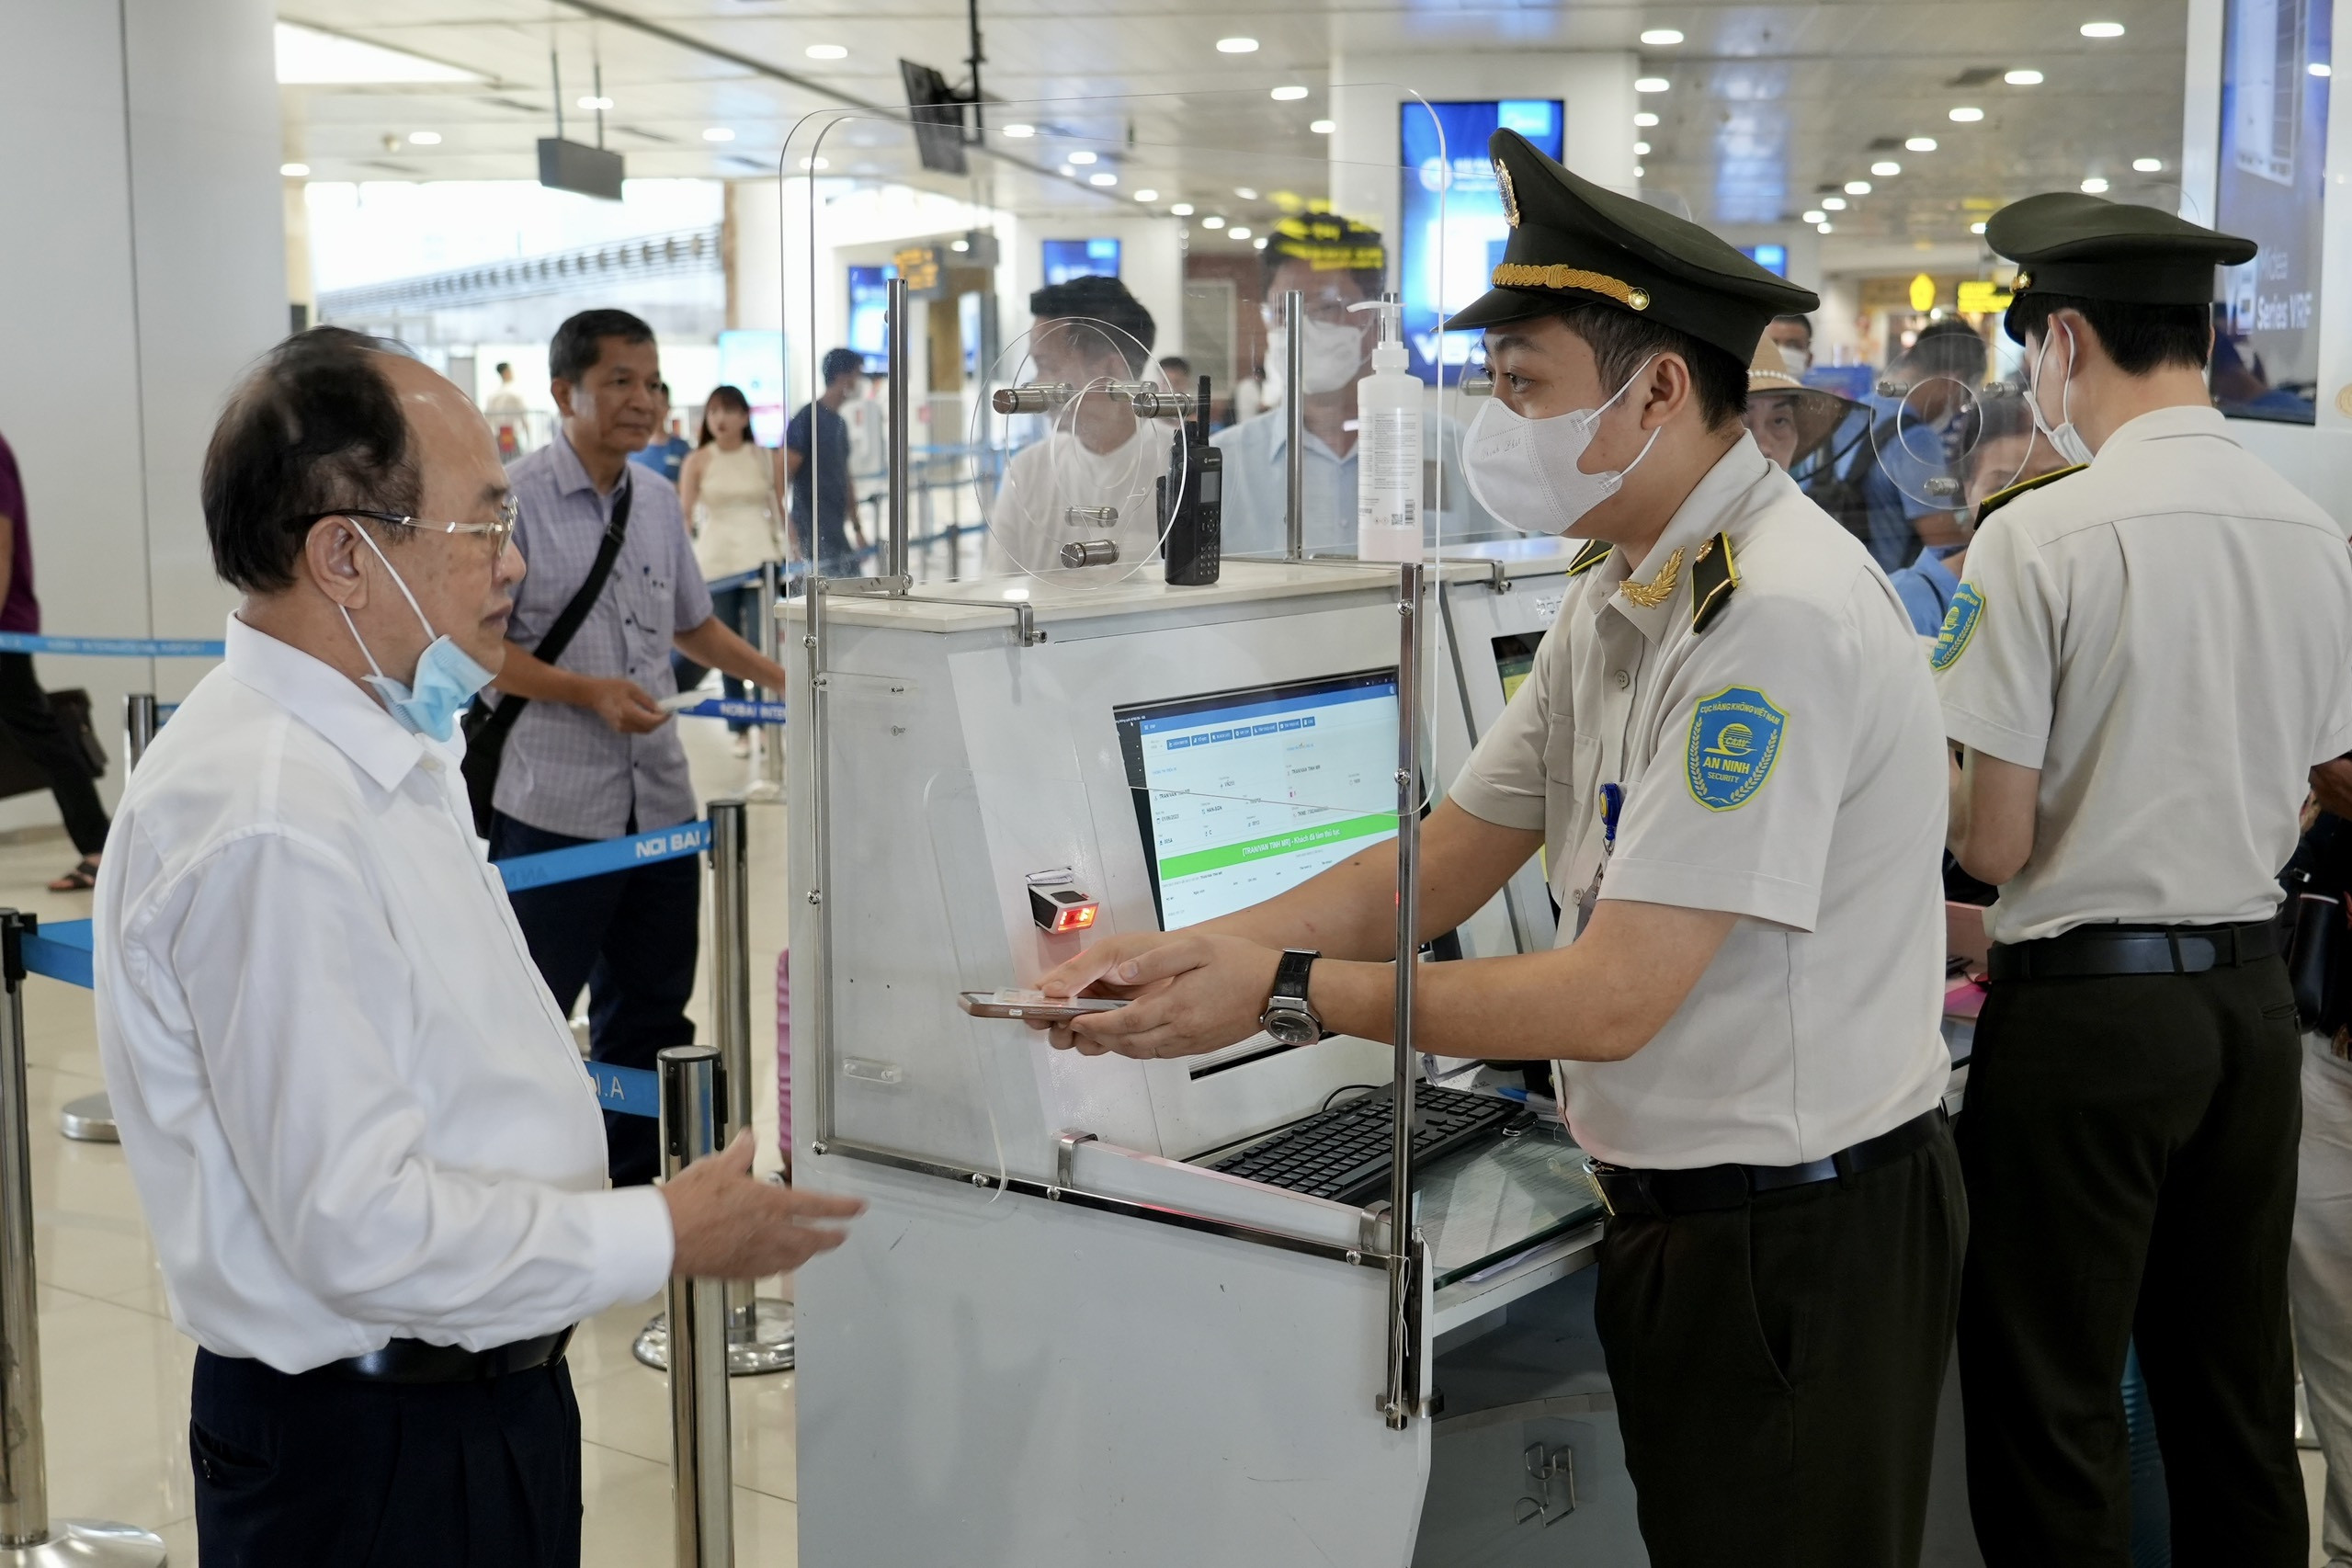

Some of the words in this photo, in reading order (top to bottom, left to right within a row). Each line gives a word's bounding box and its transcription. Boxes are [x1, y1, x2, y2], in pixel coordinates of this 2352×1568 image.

[2257, 294, 2288, 331] Series
[1712, 700, 1731, 711] HÀNG
[1731, 701, 1754, 713] KHÔNG
[1765, 712, 1780, 725] NAM
[1702, 756, 1721, 770] AN
[1721, 759, 1751, 775] NINH
[1707, 771, 1740, 783] SECURITY
[636, 835, 667, 858] NOI
[670, 830, 700, 852] BAI
